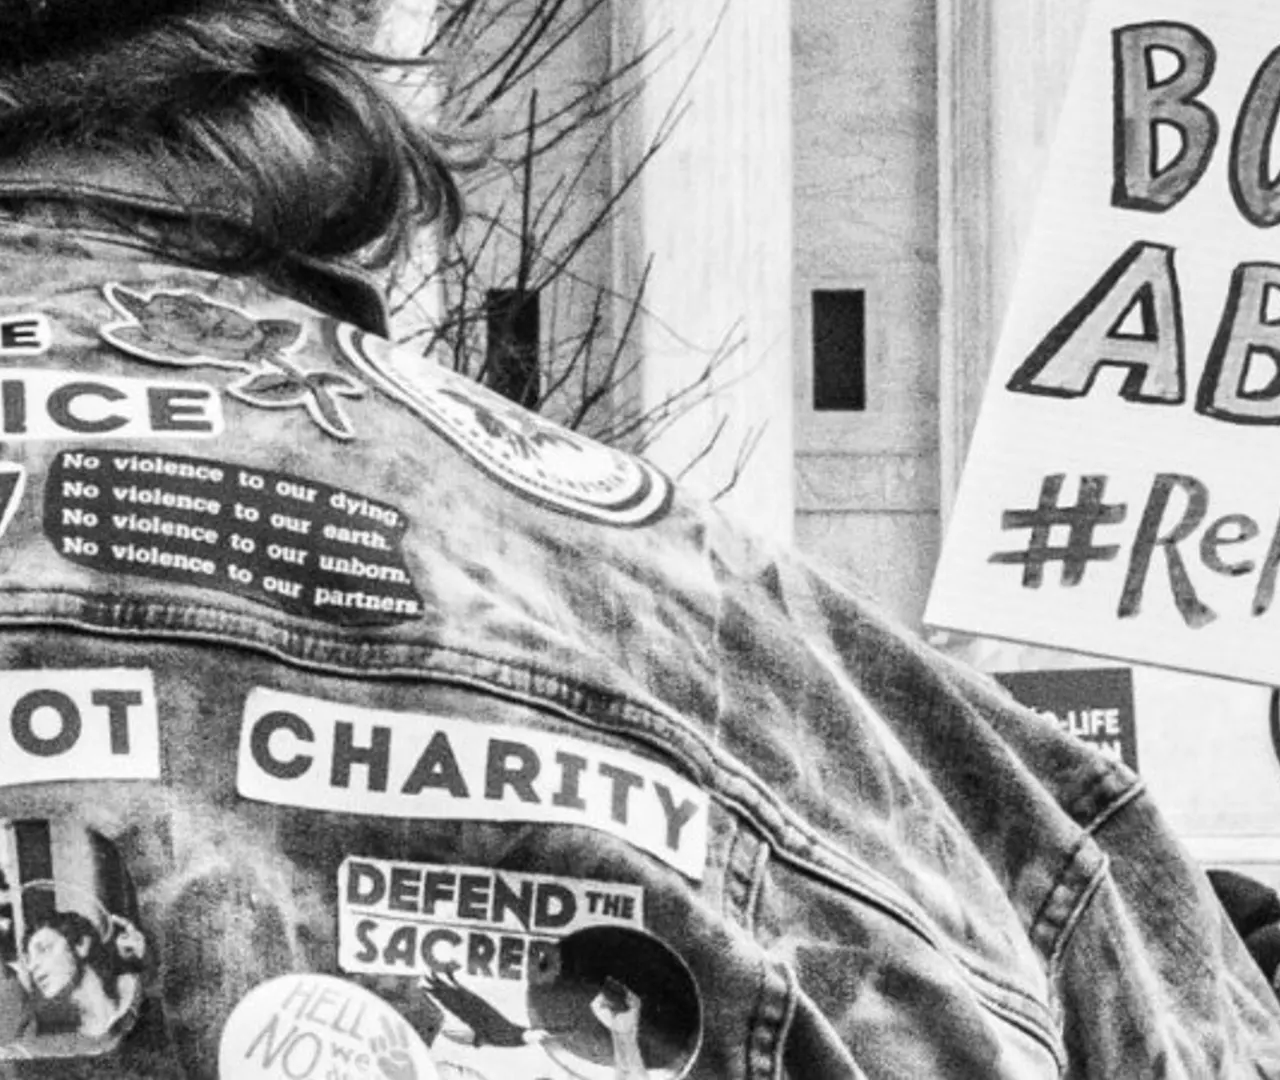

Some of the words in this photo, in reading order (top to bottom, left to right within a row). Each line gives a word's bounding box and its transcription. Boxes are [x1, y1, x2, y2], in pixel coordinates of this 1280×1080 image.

[62, 453, 100, 470] No
[112, 456, 224, 483] violence
[238, 471, 265, 491] to
[275, 478, 318, 504] our
[328, 493, 405, 530] dying.
[62, 481, 100, 499] No
[112, 486, 221, 515] violence
[234, 502, 260, 523] to
[270, 512, 312, 535] our
[322, 523, 394, 553] earth.
[61, 508, 99, 528] No
[112, 514, 219, 545] violence
[230, 533, 256, 554] to
[266, 544, 309, 566] our
[319, 555, 412, 586] unborn.
[62, 537, 99, 557] No
[111, 543, 217, 576] violence
[228, 564, 254, 585] to
[262, 575, 303, 599] our
[248, 709, 702, 854] CHARITY
[346, 861, 578, 930] DEFEND
[585, 890, 636, 920] THE
[280, 979, 368, 1042] HELL
[243, 1013, 324, 1080] NO
